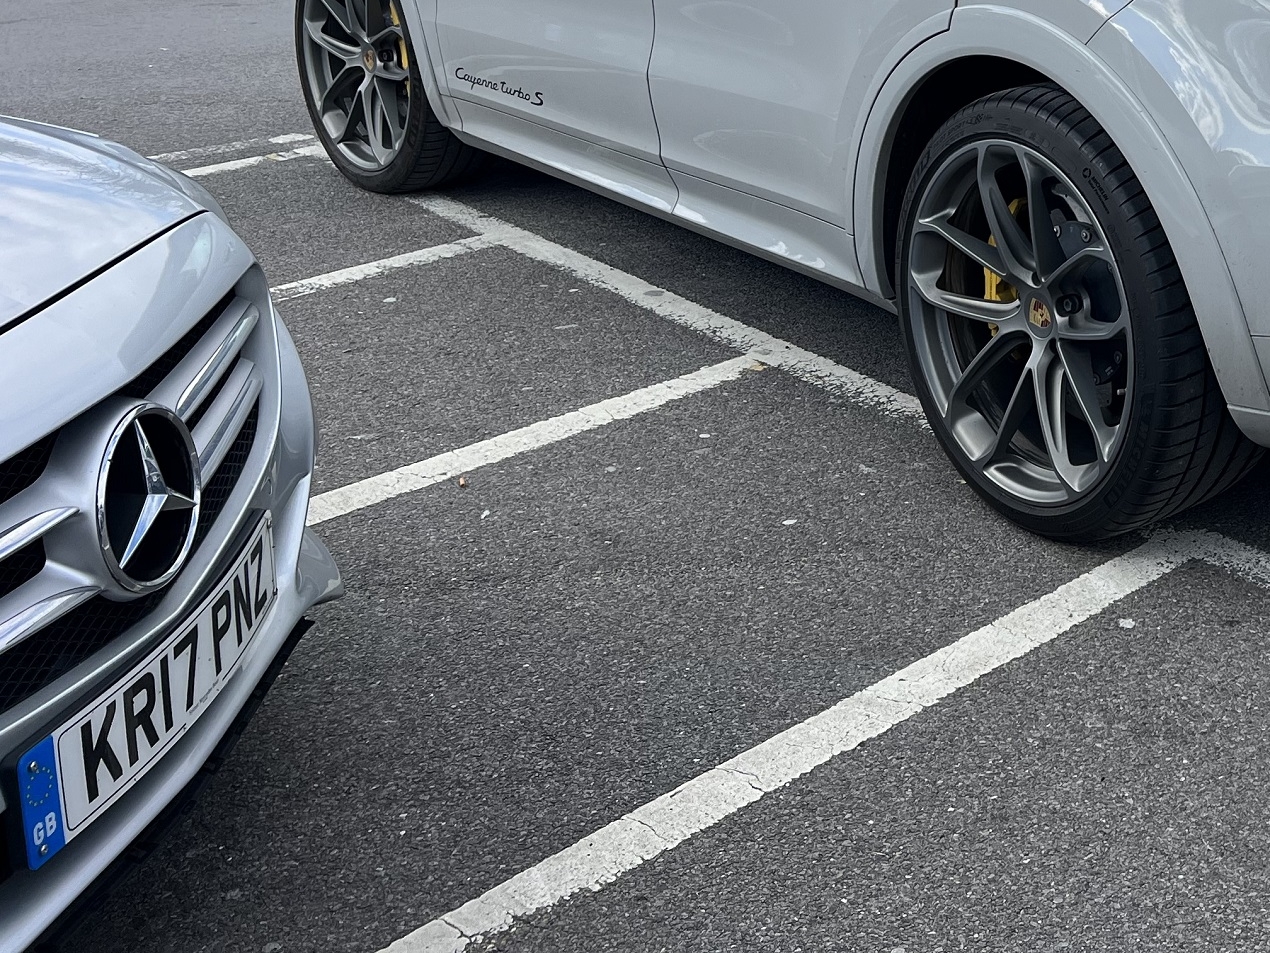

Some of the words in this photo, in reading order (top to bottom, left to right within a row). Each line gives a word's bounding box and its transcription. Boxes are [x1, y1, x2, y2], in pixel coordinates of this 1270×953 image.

[455, 67, 499, 90] Cayenne
[530, 92, 544, 106] S
[80, 623, 199, 805] KR17
[211, 534, 268, 678] PNZ
[32, 810, 57, 846] GB
